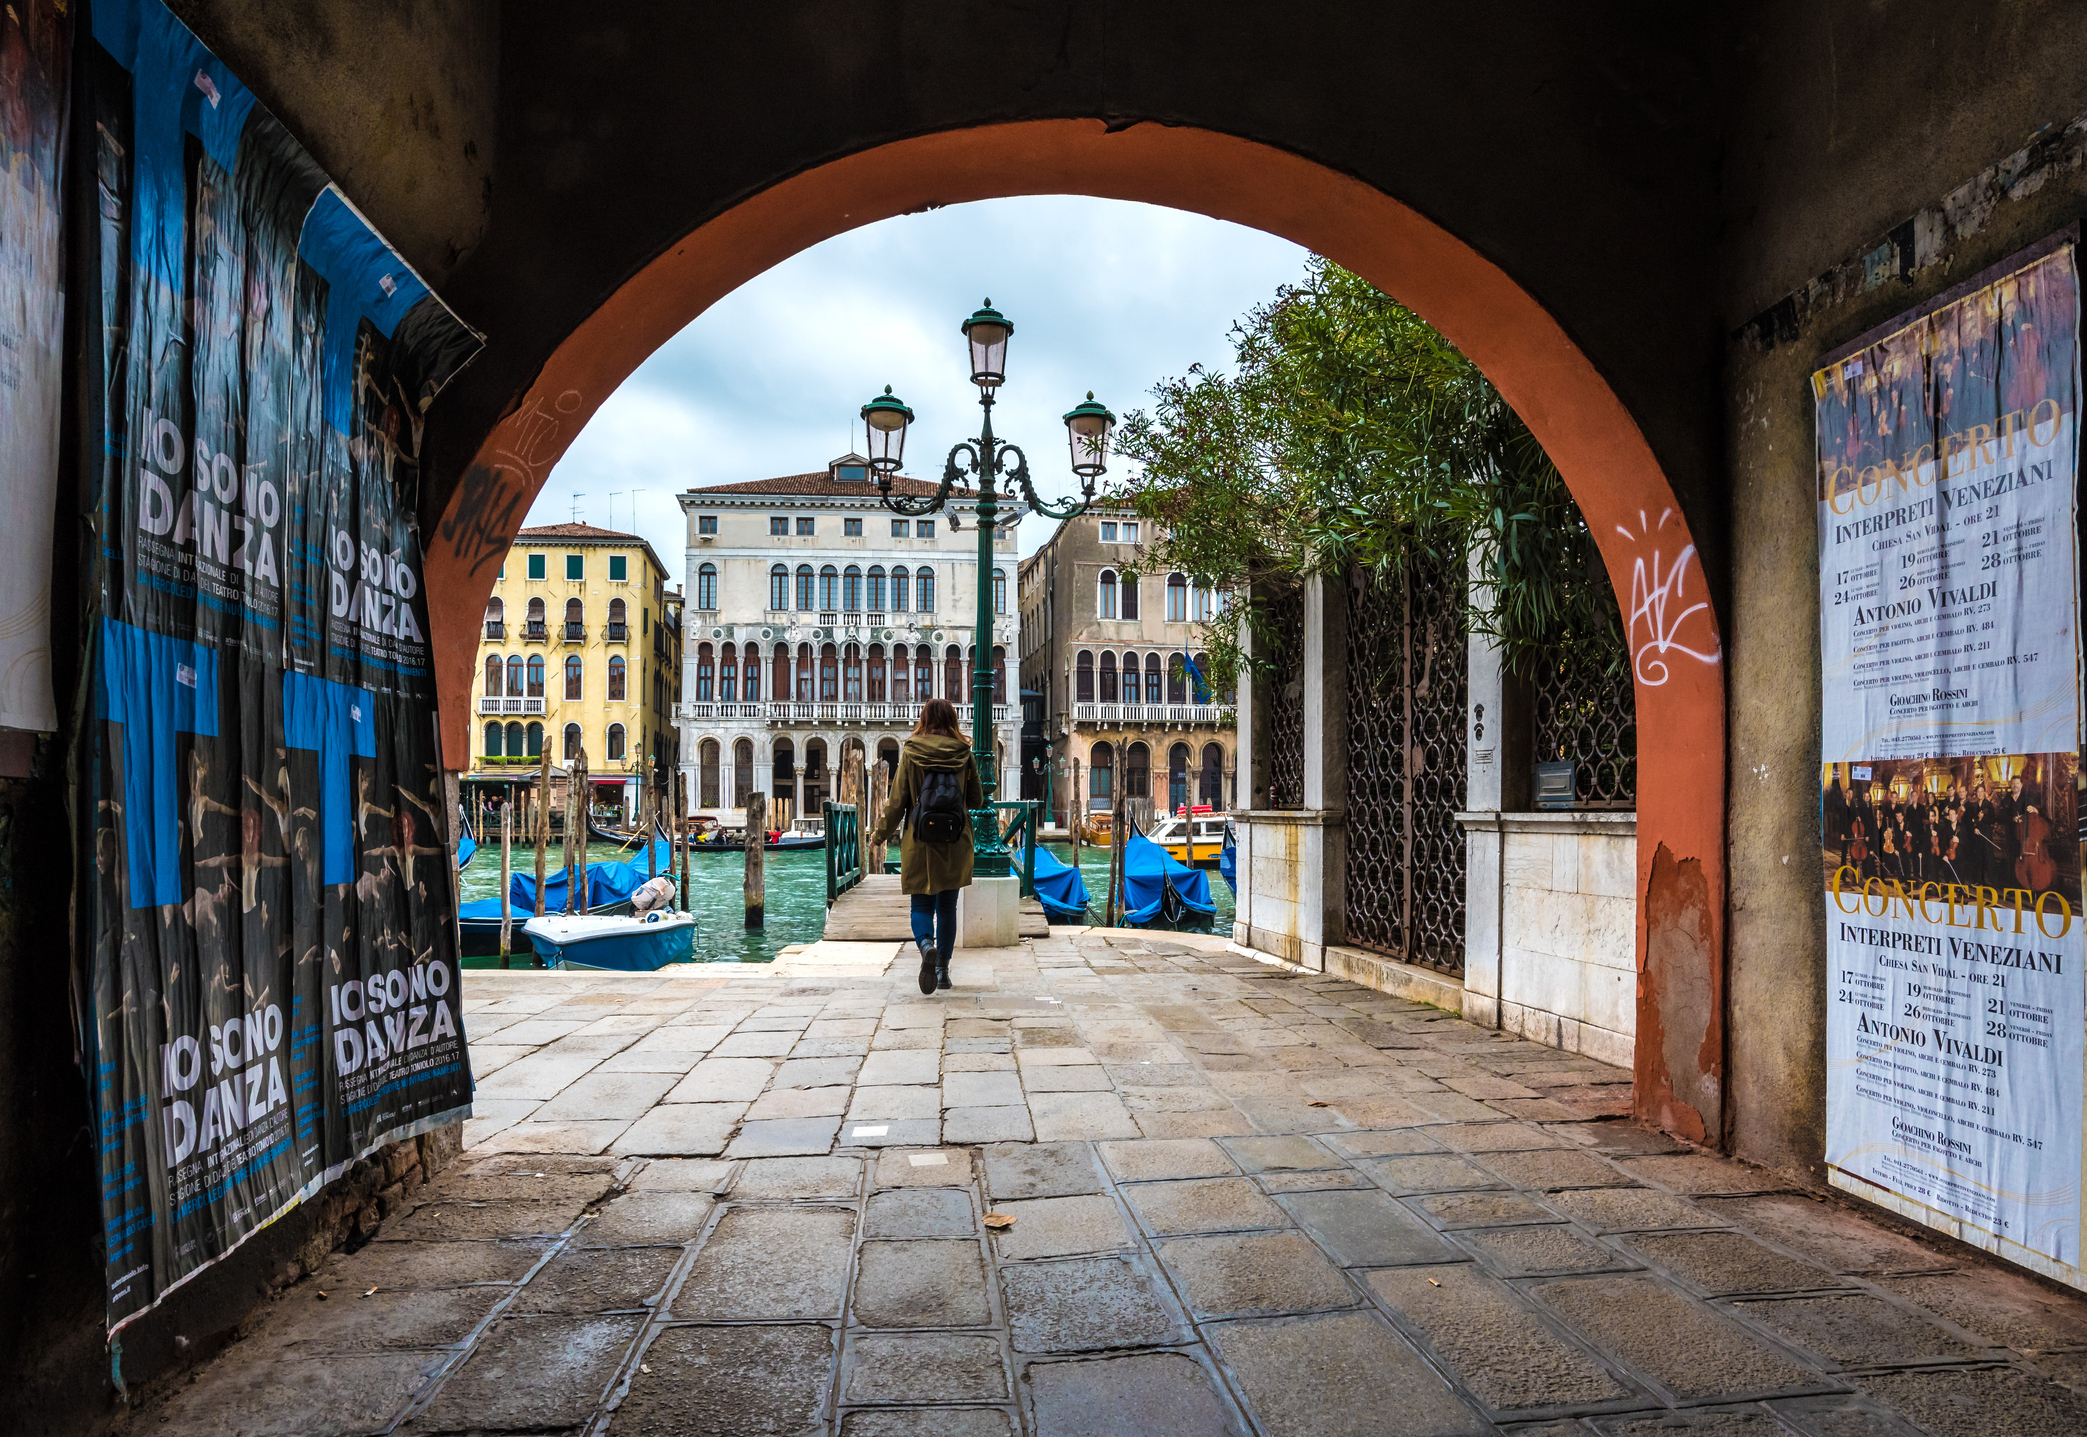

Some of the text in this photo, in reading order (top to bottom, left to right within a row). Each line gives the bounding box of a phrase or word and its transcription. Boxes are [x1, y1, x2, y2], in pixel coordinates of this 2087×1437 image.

[141, 405, 280, 528] IO SONO
[1828, 399, 2061, 515] CONCERTO
[1836, 459, 2053, 544] INTERPRETI VENEZIANI
[139, 467, 280, 588] DANZA
[1872, 504, 2000, 552] CHIESA SAN VIDAL ORE 21
[1982, 526, 2042, 548] 21 OTTOBRE
[138, 535, 175, 559] RASSEGNA
[331, 524, 355, 571] IO
[1901, 550, 1950, 569] 19 OTTOBRE
[1981, 549, 2042, 571] 28 OTTOBRE
[138, 554, 171, 576] STAGIONE
[212, 582, 239, 600] TEATRO
[258, 602, 278, 616] 2016.17
[1836, 570, 1849, 586] 17
[1850, 569, 1878, 582] OTTOBRE
[1900, 572, 1950, 590] 26 OTTOBRE
[331, 571, 425, 643] DANZA
[1834, 589, 1878, 605] 24 OTTOBRE
[1853, 580, 1998, 626] ANTONIO VIVALDI
[1853, 627, 1877, 637] CONCERTO
[1934, 611, 1962, 620] CEMBALO
[1964, 607, 1976, 616] RV.
[1978, 603, 1991, 613] 273
[371, 646, 387, 659] TEATRO
[402, 655, 426, 666] 2016.17
[1853, 644, 1877, 653] CONCERTO
[1916, 634, 1930, 642] ARCHI
[1936, 628, 1964, 638] CEMBALO
[1966, 624, 1979, 633] RV.
[1853, 662, 1878, 670] CONCERTO
[1934, 648, 1962, 657] CEMBALO
[1964, 644, 1976, 652] RV.
[1978, 641, 1990, 650] 211
[1853, 678, 1878, 686] CONCERTO
[1954, 664, 1970, 673] ARCHI
[1978, 660, 2005, 669] CEMBALO
[2007, 655, 2020, 665] RV.
[2023, 652, 2039, 663] 547
[1889, 706, 1917, 715] CONCERTO
[1962, 700, 1978, 708] ARCHI
[1890, 688, 1968, 706] GIOACHINO ROSSINI
[1833, 865, 2072, 939] CONCERTO
[1840, 922, 2062, 975] INTERPRETI VENEZIANI
[1841, 970, 1884, 991] 17 OTTOBRE
[1879, 954, 2006, 988] CHIESA SAN VIDAL ORE 21
[331, 959, 450, 1026] IO SONO
[1839, 989, 1884, 1011] 24 OTTOBRE
[1907, 982, 1955, 1005] 19 OTTOBRE
[2036, 1006, 2053, 1014] FRIDAY
[1904, 1003, 1955, 1027] 26 OTTOBRE
[1988, 998, 2048, 1024] 21 OTTOBRE
[159, 1034, 201, 1098] IO
[209, 1003, 284, 1077] SONO
[333, 999, 459, 1077] DANZA
[1857, 1012, 2003, 1067] ANTONIO VIVALDI
[1986, 1021, 2048, 1048] 28 OTTOBRE
[339, 1073, 368, 1091] RASSEGNA
[430, 1040, 458, 1055] D'AUTORE
[389, 1066, 409, 1080] TEATRO
[435, 1051, 460, 1066] 2016.17
[416, 1062, 461, 1081] ABBONAMENTI
[1856, 1035, 1882, 1047] CONCERTO
[1894, 1046, 1916, 1058] VIOLINO,
[1918, 1053, 1934, 1061] ARCHI
[1941, 1059, 1966, 1070] CEMBALO
[1968, 1063, 1980, 1074] RV.
[1982, 1068, 1996, 1078] 273
[1856, 1051, 1882, 1064] CONCERTO
[1894, 1063, 1918, 1075] FAGOTTO,
[1920, 1071, 1935, 1080] ARCHI
[1942, 1077, 1969, 1089] CEMBALO
[1971, 1082, 1982, 1093] RV.
[1856, 1068, 1882, 1081] CONCERTO
[1894, 1080, 1916, 1092] VIOLINO,
[1918, 1088, 1933, 1097] ARCHI
[1940, 1094, 1966, 1107] CEMBALO
[1968, 1100, 1980, 1111] RV.
[1982, 1105, 1995, 1116] 211
[163, 1055, 288, 1169] DANZA
[1856, 1084, 1882, 1098] CONCERTO
[1893, 1097, 1915, 1109] VIOLINO,
[1917, 1105, 1955, 1122] VIOLONCELLO,
[1957, 1118, 1974, 1128] ARCHI
[1982, 1126, 2010, 1139] CEMBALO
[2012, 1133, 2024, 1144] RV.
[2027, 1138, 2043, 1150] 547
[1891, 1129, 1919, 1145] CONCERTO
[1920, 1141, 1931, 1149] PER
[1932, 1145, 1957, 1158] FAGOTTO
[1965, 1157, 1982, 1168] ARCHI
[1892, 1116, 1935, 1141] GIOACHINO
[1937, 1131, 1971, 1154] ROSSINI
[1918, 1186, 1925, 1195] 28
[1993, 1216, 2002, 1226] 23
